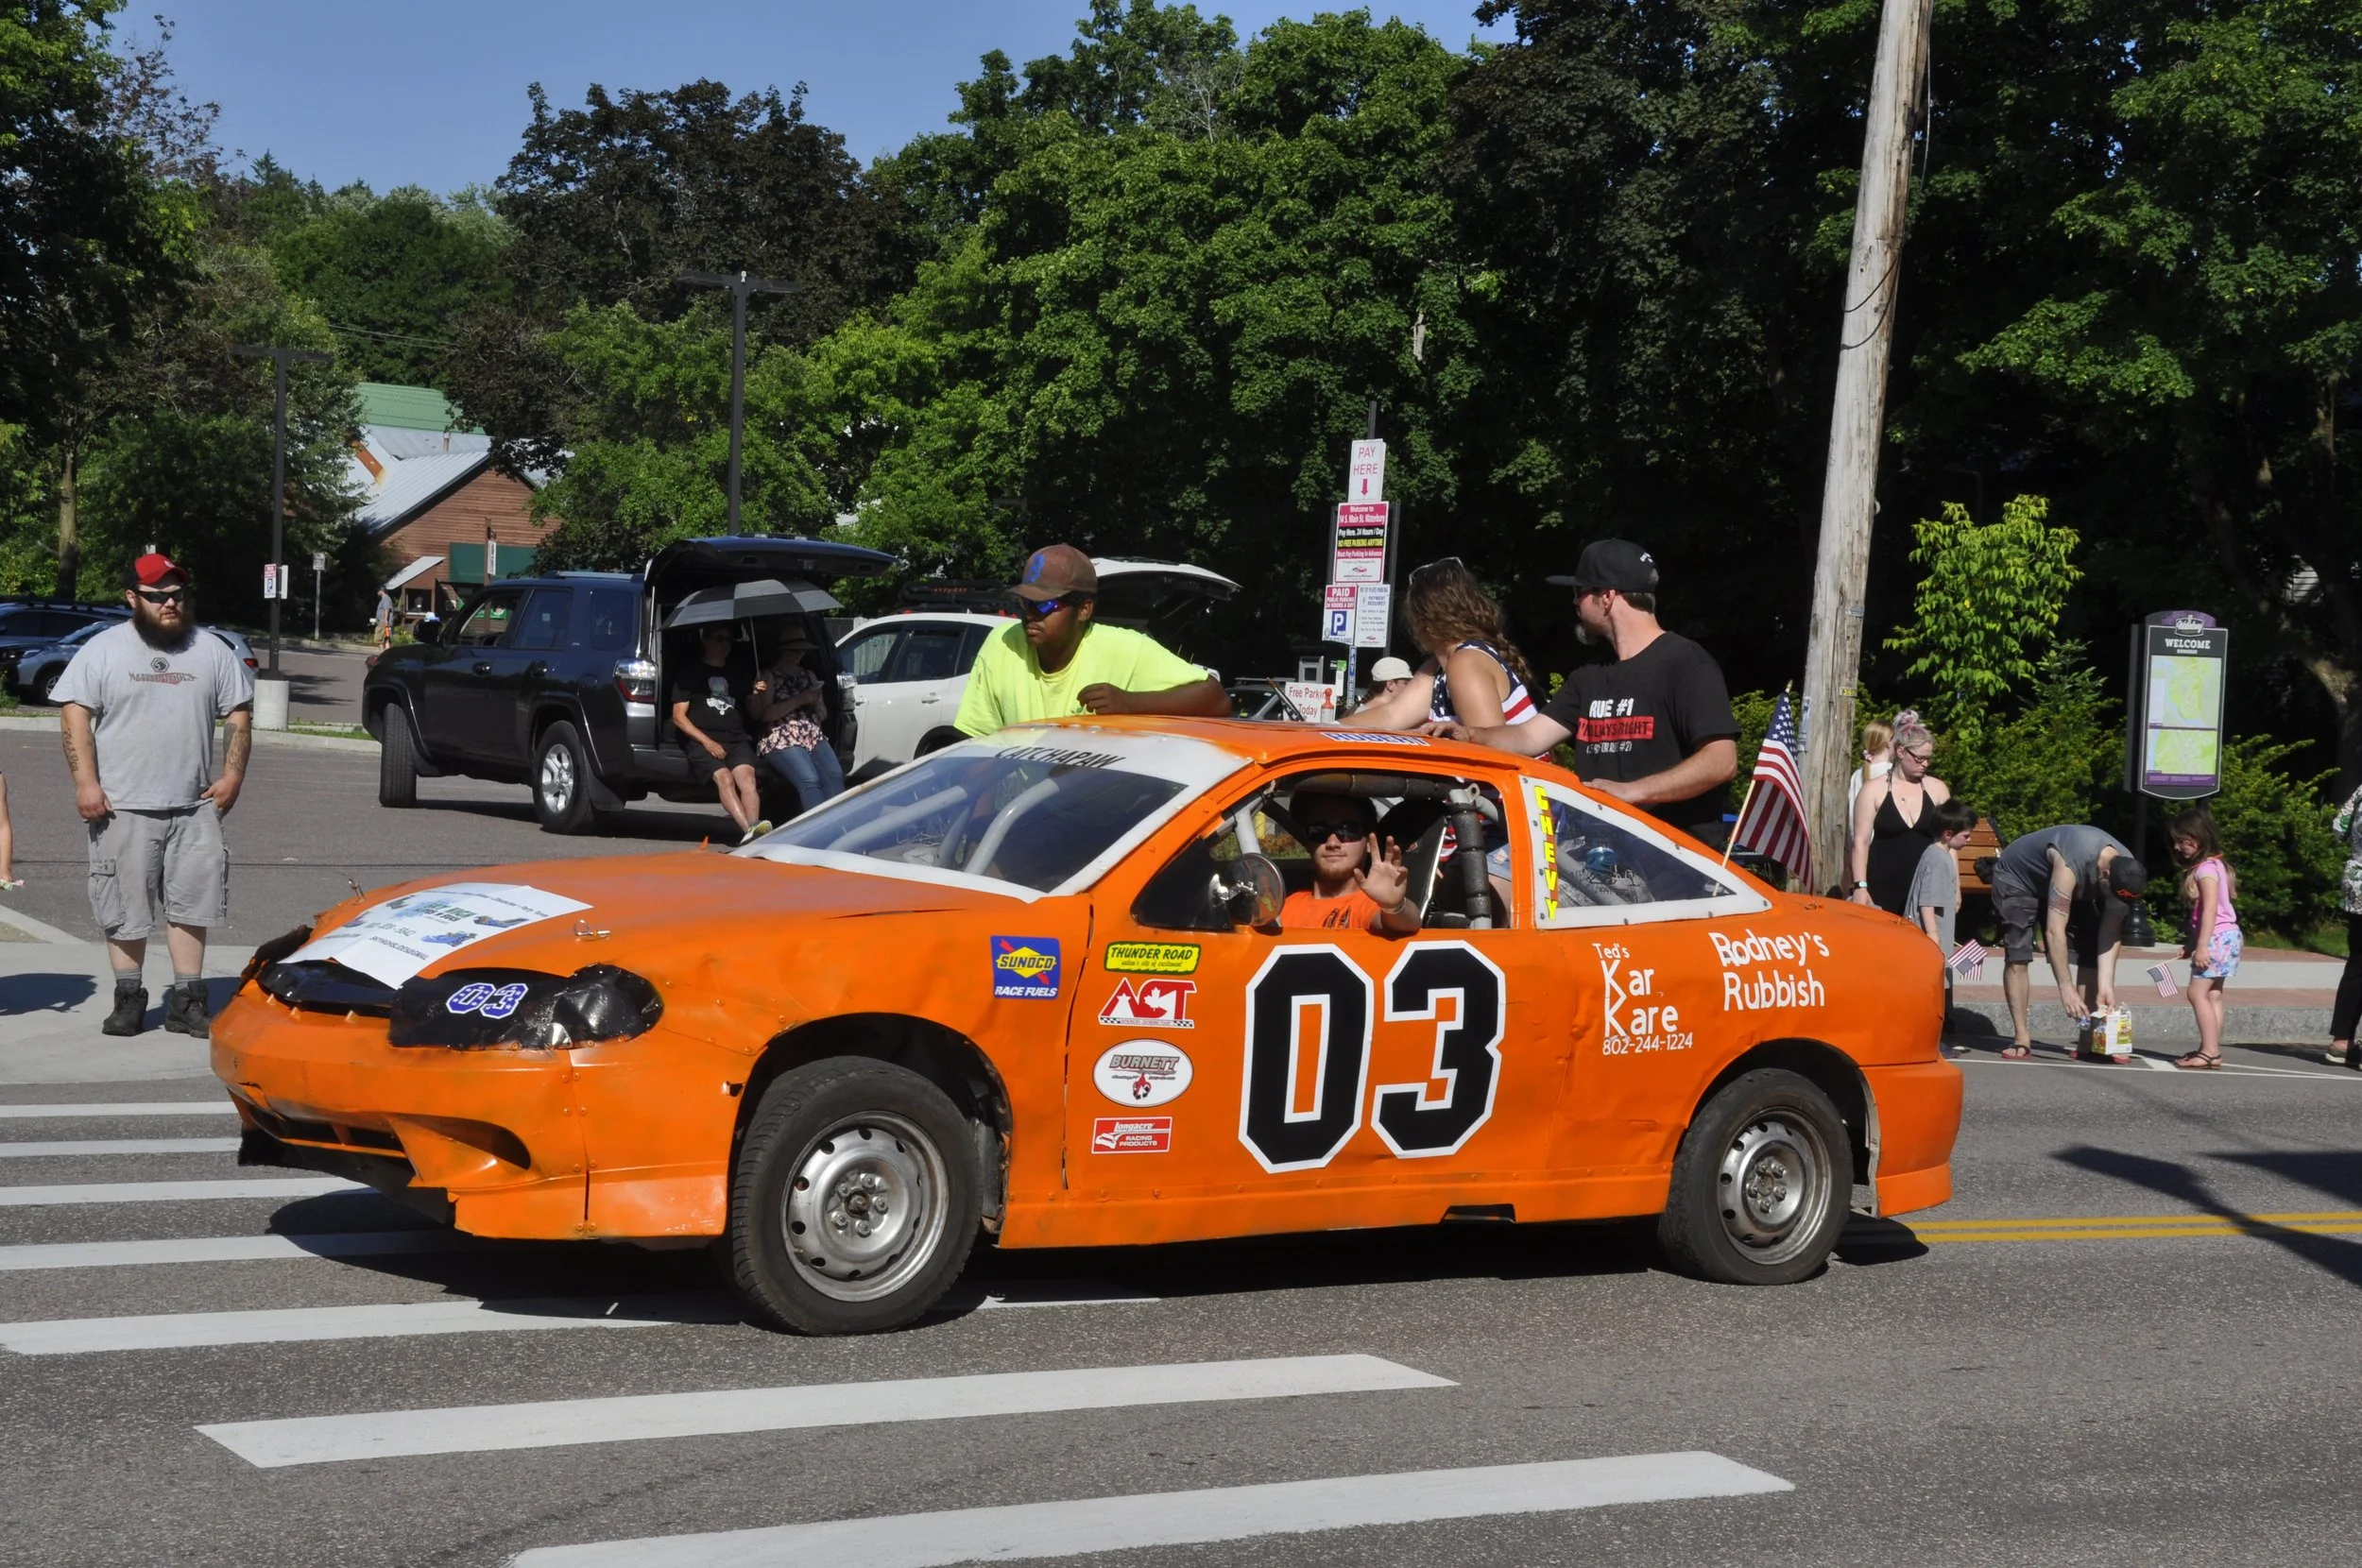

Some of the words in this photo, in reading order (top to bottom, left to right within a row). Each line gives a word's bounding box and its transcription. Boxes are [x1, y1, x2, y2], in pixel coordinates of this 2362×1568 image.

[1359, 447, 1376, 458] PAY
[1353, 464, 1378, 475] HERE
[1376, 527, 1384, 537] Day
[1332, 588, 1350, 597] PAID
[1333, 613, 1344, 634] P
[2165, 639, 2211, 649] WELCOME
[1289, 687, 1303, 697] Free
[1298, 704, 1318, 718] Today
[1617, 698, 1635, 717] #1
[1618, 722, 1650, 736] RIGHT
[1533, 785, 1559, 921] CHEVY
[1110, 947, 1161, 959] THUNDER
[1162, 948, 1193, 960] ROAD
[1592, 943, 1630, 960] Ted's
[1708, 929, 1829, 966] Rodney's
[999, 955, 1054, 969] SUNOCO
[1600, 960, 1654, 997] Kar
[995, 986, 1025, 996] RACE
[1024, 986, 1058, 997] FUELS
[1723, 969, 1825, 1011] Rubbish
[446, 982, 529, 1019] 03
[1099, 977, 1197, 1020] ACT
[1604, 997, 1679, 1037] Kare
[1602, 1032, 1693, 1055] 802-244-1224
[1109, 1054, 1180, 1069] BURNETT
[1239, 940, 1506, 1174] 03
